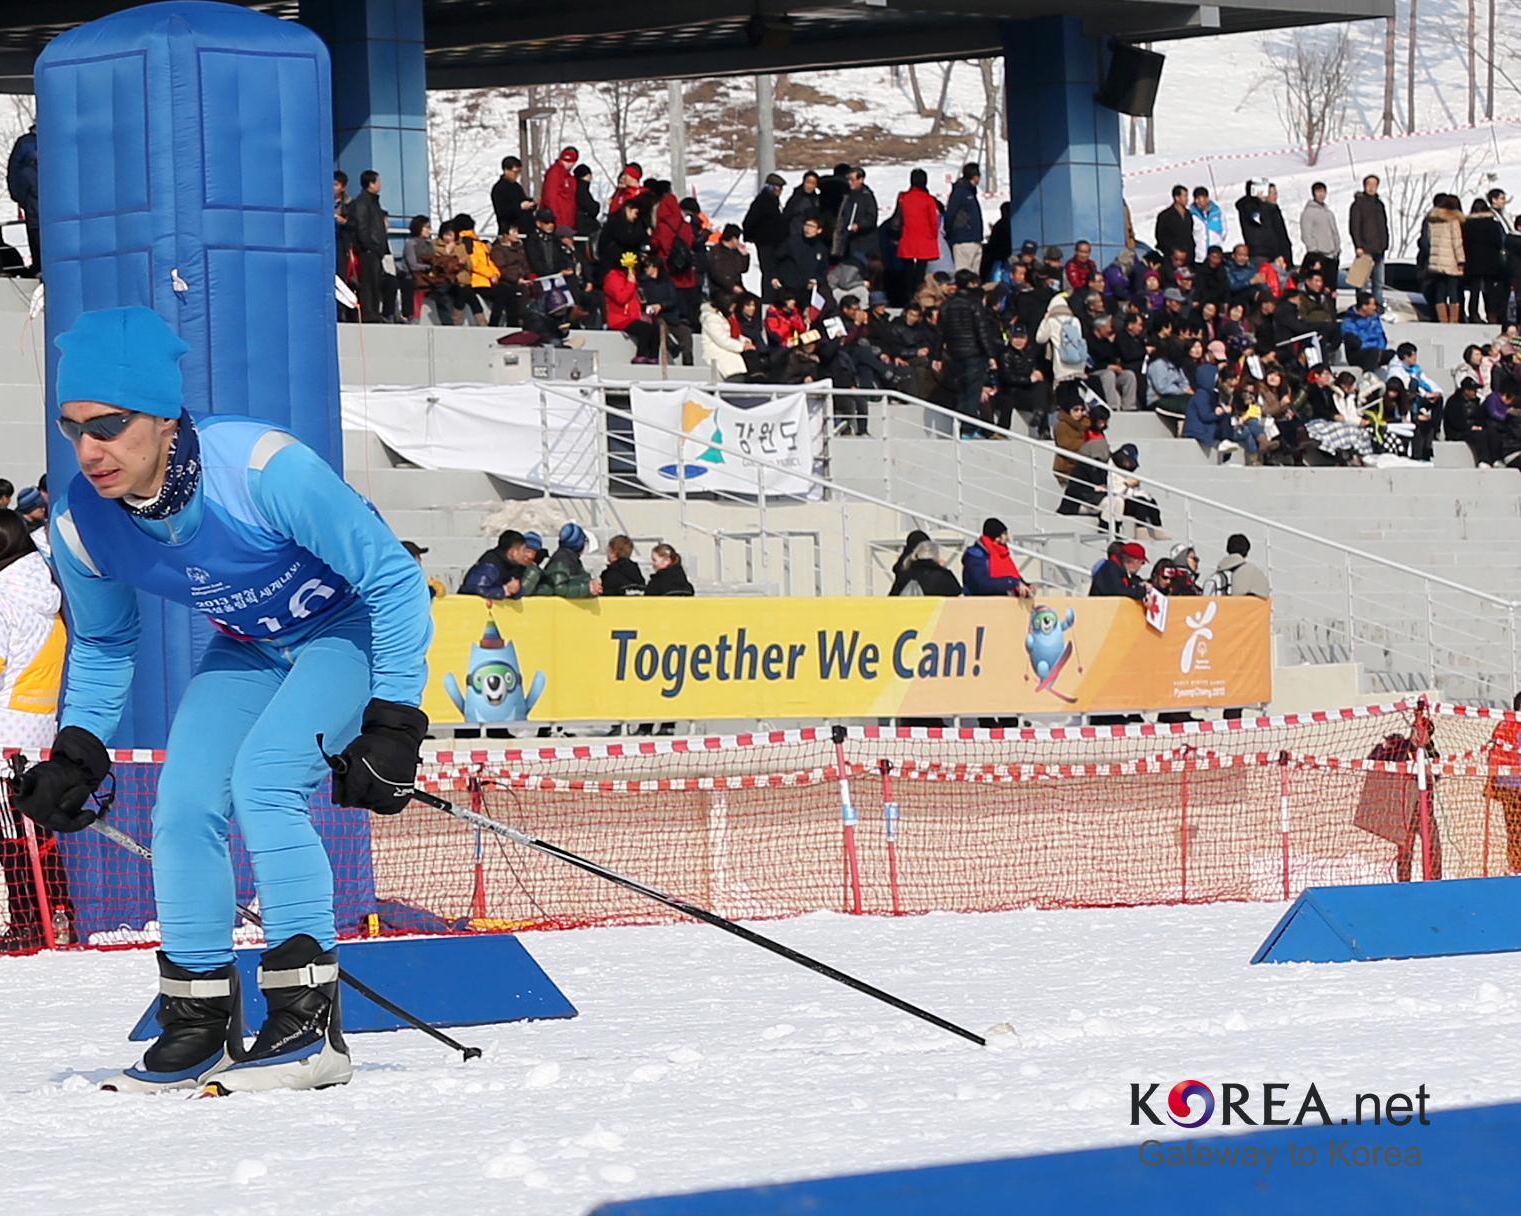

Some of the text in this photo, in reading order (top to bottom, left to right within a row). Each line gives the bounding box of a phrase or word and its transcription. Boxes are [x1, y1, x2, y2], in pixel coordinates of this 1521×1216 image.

[734, 420, 798, 455] 강원도
[610, 626, 986, 698] Together We Can!
